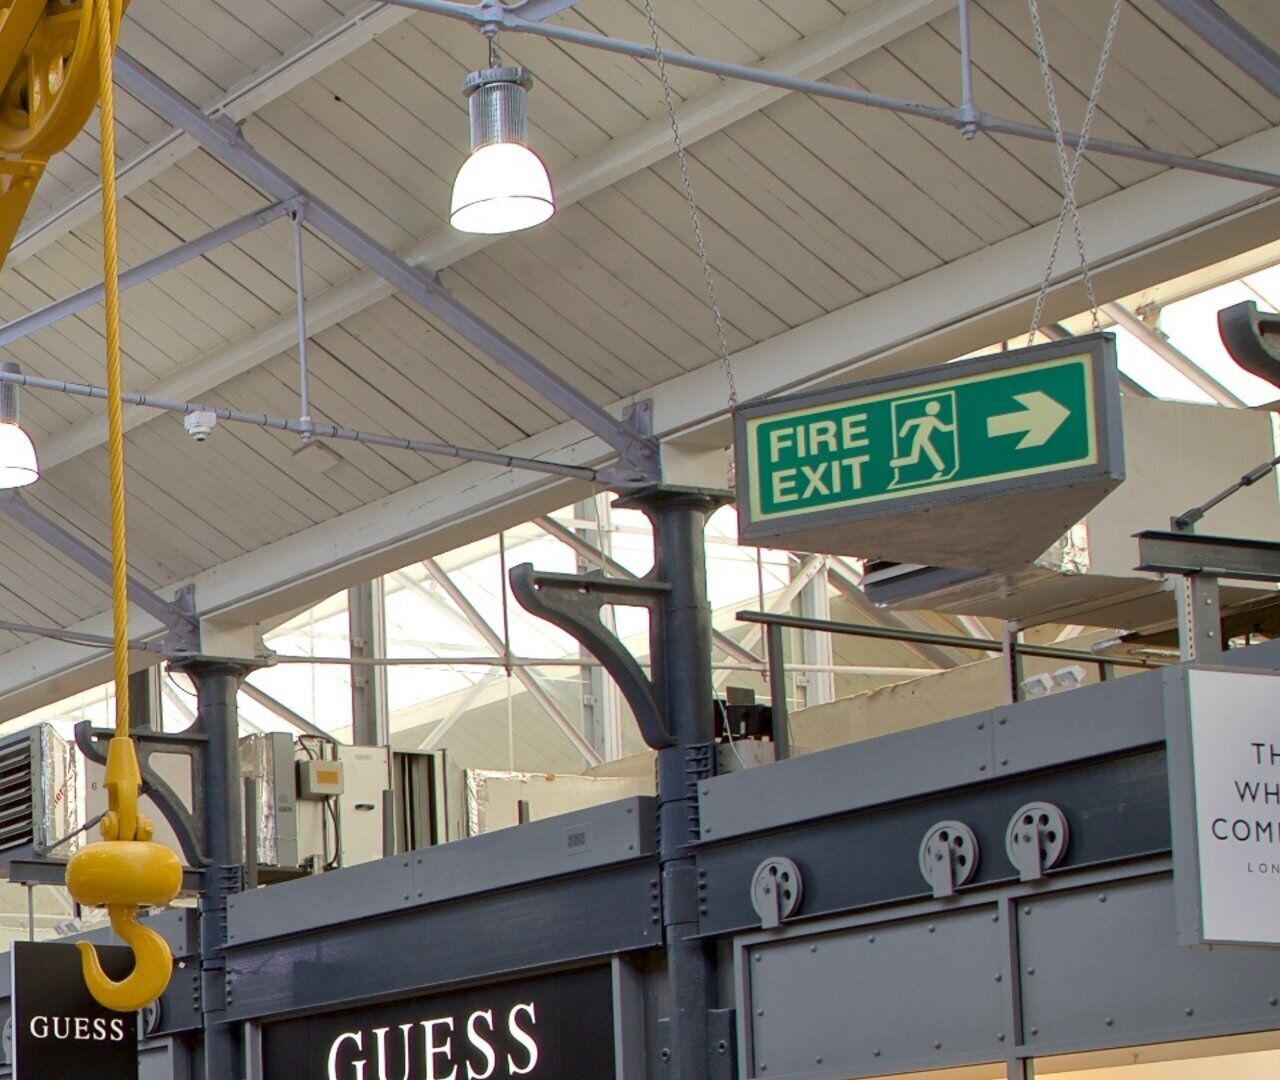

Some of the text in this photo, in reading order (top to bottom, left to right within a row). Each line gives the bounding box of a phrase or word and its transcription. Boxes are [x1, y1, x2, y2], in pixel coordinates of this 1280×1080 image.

[769, 413, 870, 463] FIRE
[771, 455, 870, 504] EXIT
[1212, 818, 1280, 843] COM
[30, 1016, 124, 1040] GUESS
